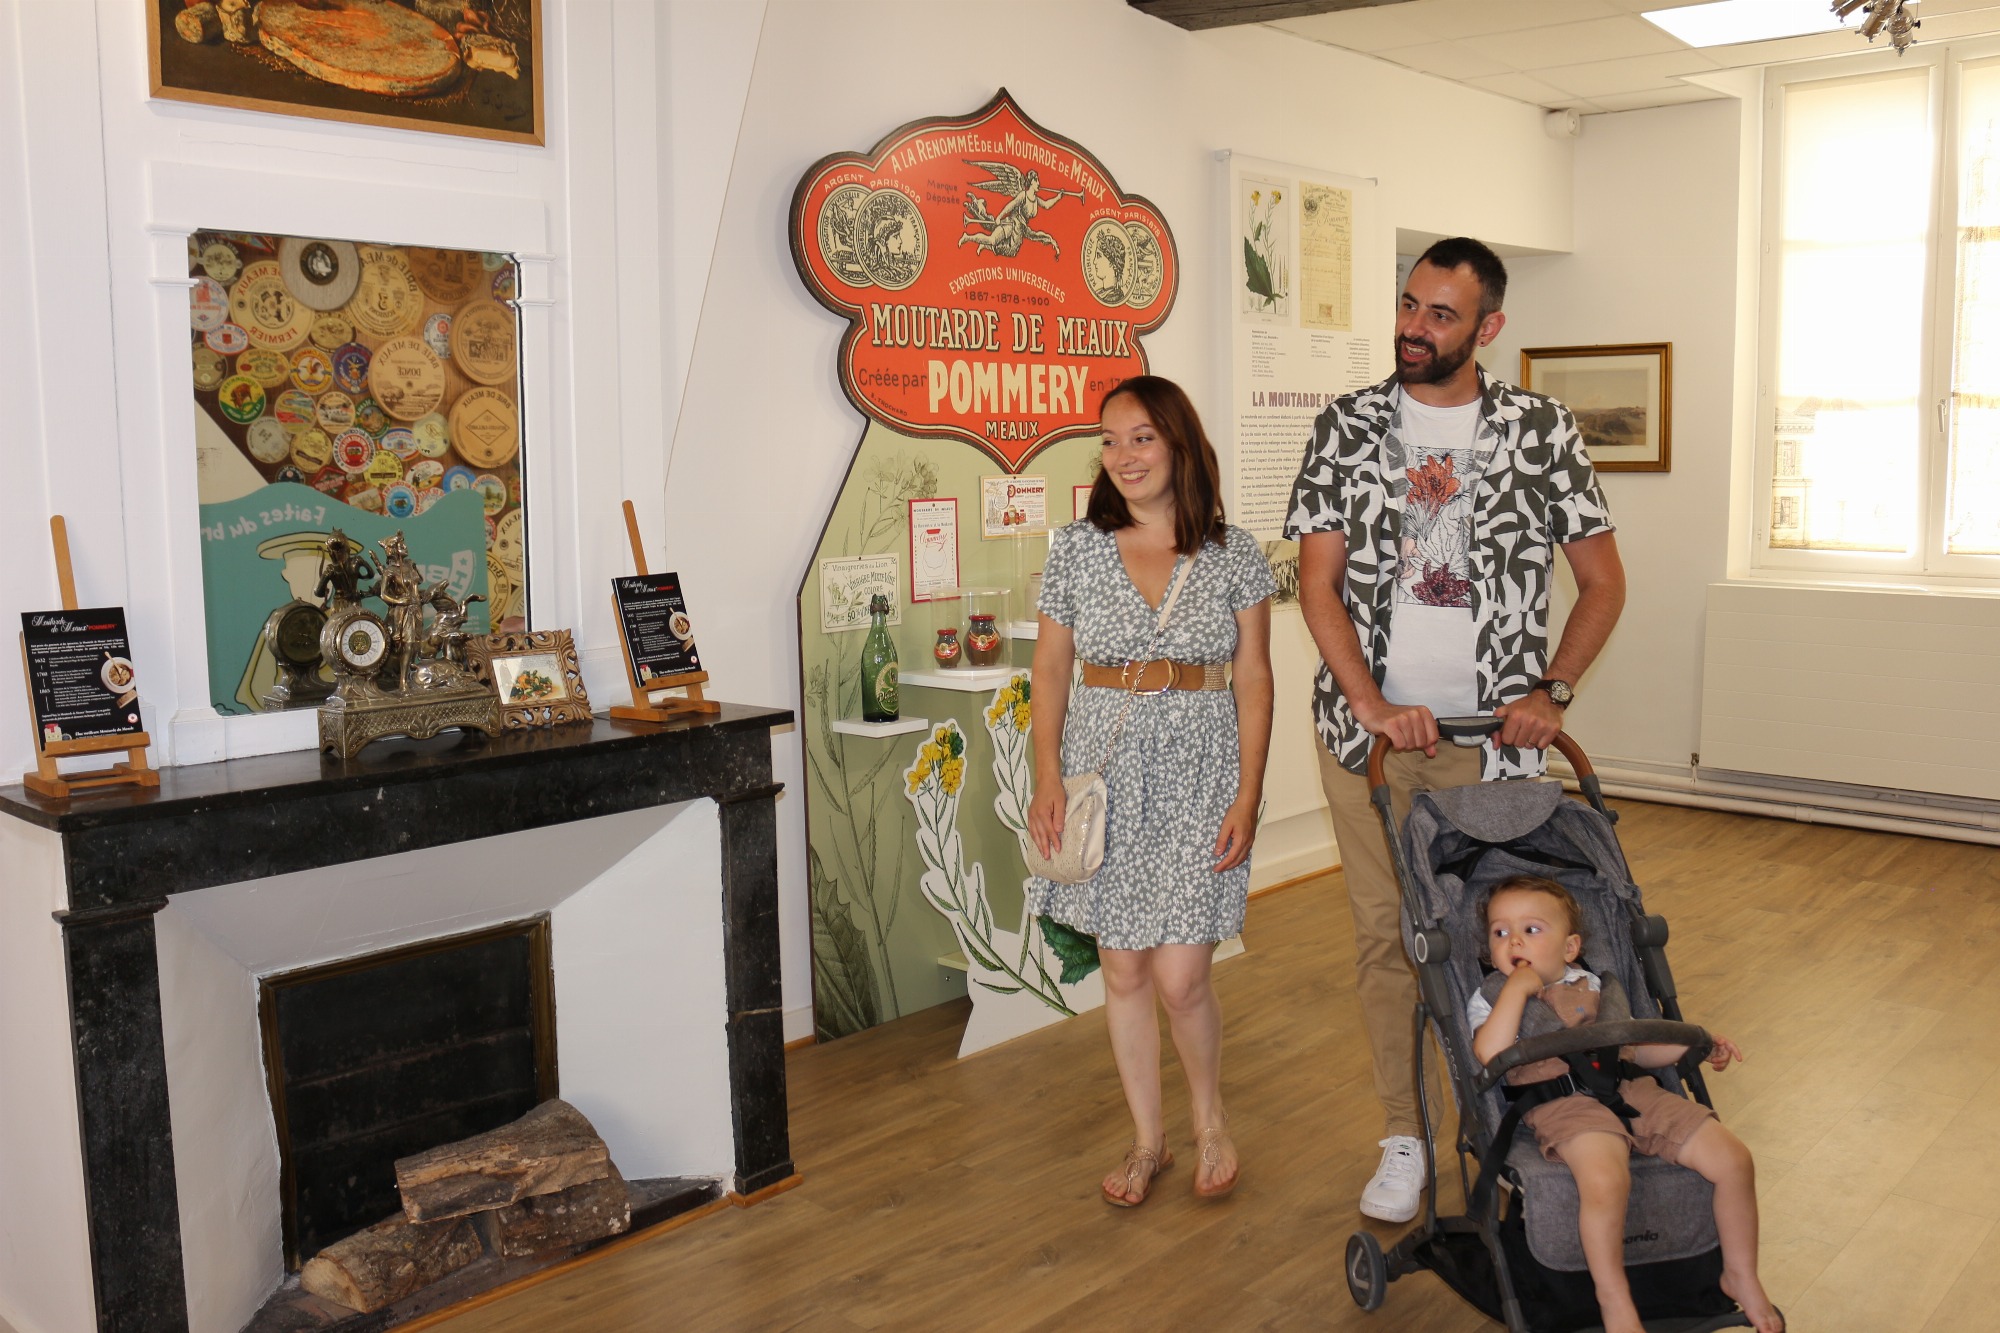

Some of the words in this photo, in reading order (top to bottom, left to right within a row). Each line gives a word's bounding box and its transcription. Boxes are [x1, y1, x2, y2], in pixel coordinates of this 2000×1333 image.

[891, 155, 902, 174] A
[902, 148, 916, 168] LA
[916, 132, 980, 162] RENOMMÉE
[981, 140, 992, 152] DE
[994, 140, 1004, 154] LA
[1005, 132, 1057, 170] MOUTARDE
[1058, 161, 1069, 177] DE
[1070, 158, 1106, 202] MEAUX
[824, 174, 864, 192] ARGENT
[870, 178, 899, 190] PARIS
[901, 184, 921, 204] 1900
[926, 192, 960, 205] Déposée
[927, 179, 958, 192] Marque
[1090, 208, 1121, 221] ARGENT
[1124, 212, 1146, 222] PARIS
[1147, 218, 1160, 238] 1878
[949, 266, 1004, 295] EXPOSITIONS
[1006, 268, 1066, 304] UNIVERSELLES
[870, 303, 1000, 352] MOUTARDE
[1012, 312, 1044, 354] DE
[1056, 316, 1132, 358] MEAUX
[858, 368, 899, 388] Créée
[902, 373, 927, 395] par
[928, 359, 1089, 415] POMMERY
[1090, 380, 1104, 391] en
[1252, 391, 1265, 406] LA
[1268, 392, 1322, 408] MOUTARDE
[985, 420, 1039, 440] MEAUX
[832, 562, 868, 572] Vinaigreries
